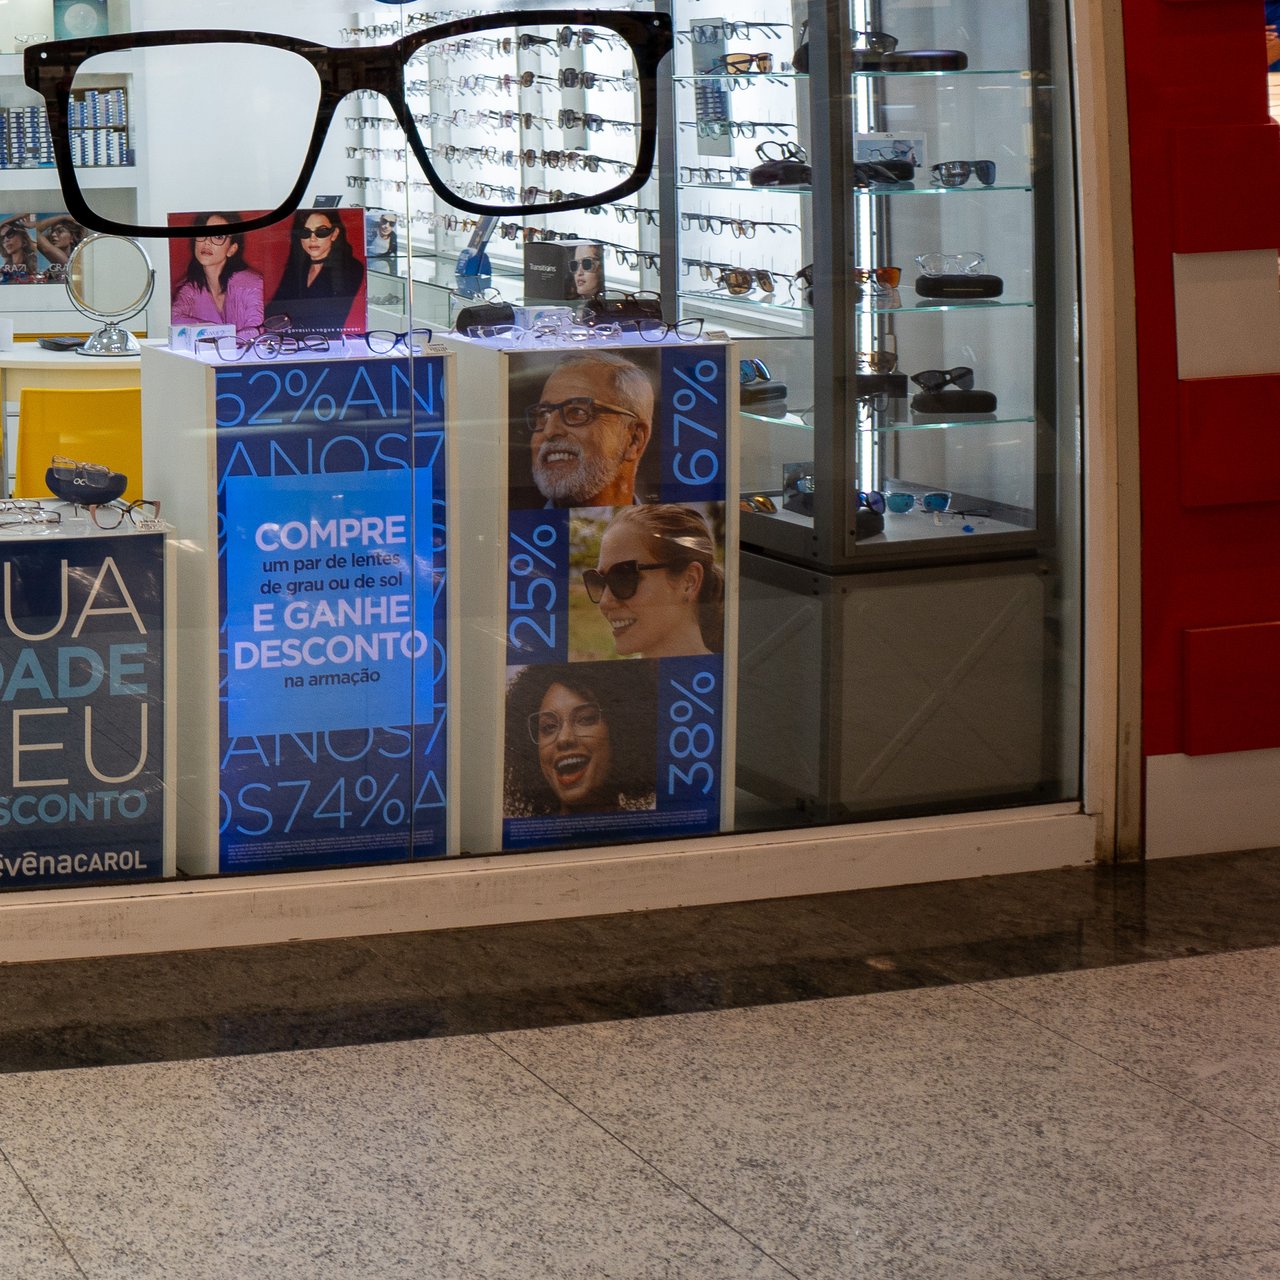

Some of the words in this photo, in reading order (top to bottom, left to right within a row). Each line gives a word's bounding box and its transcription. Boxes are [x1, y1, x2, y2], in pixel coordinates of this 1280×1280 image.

[672, 359, 718, 486] 67%
[509, 524, 557, 650] 25%
[668, 671, 716, 795] 38%
